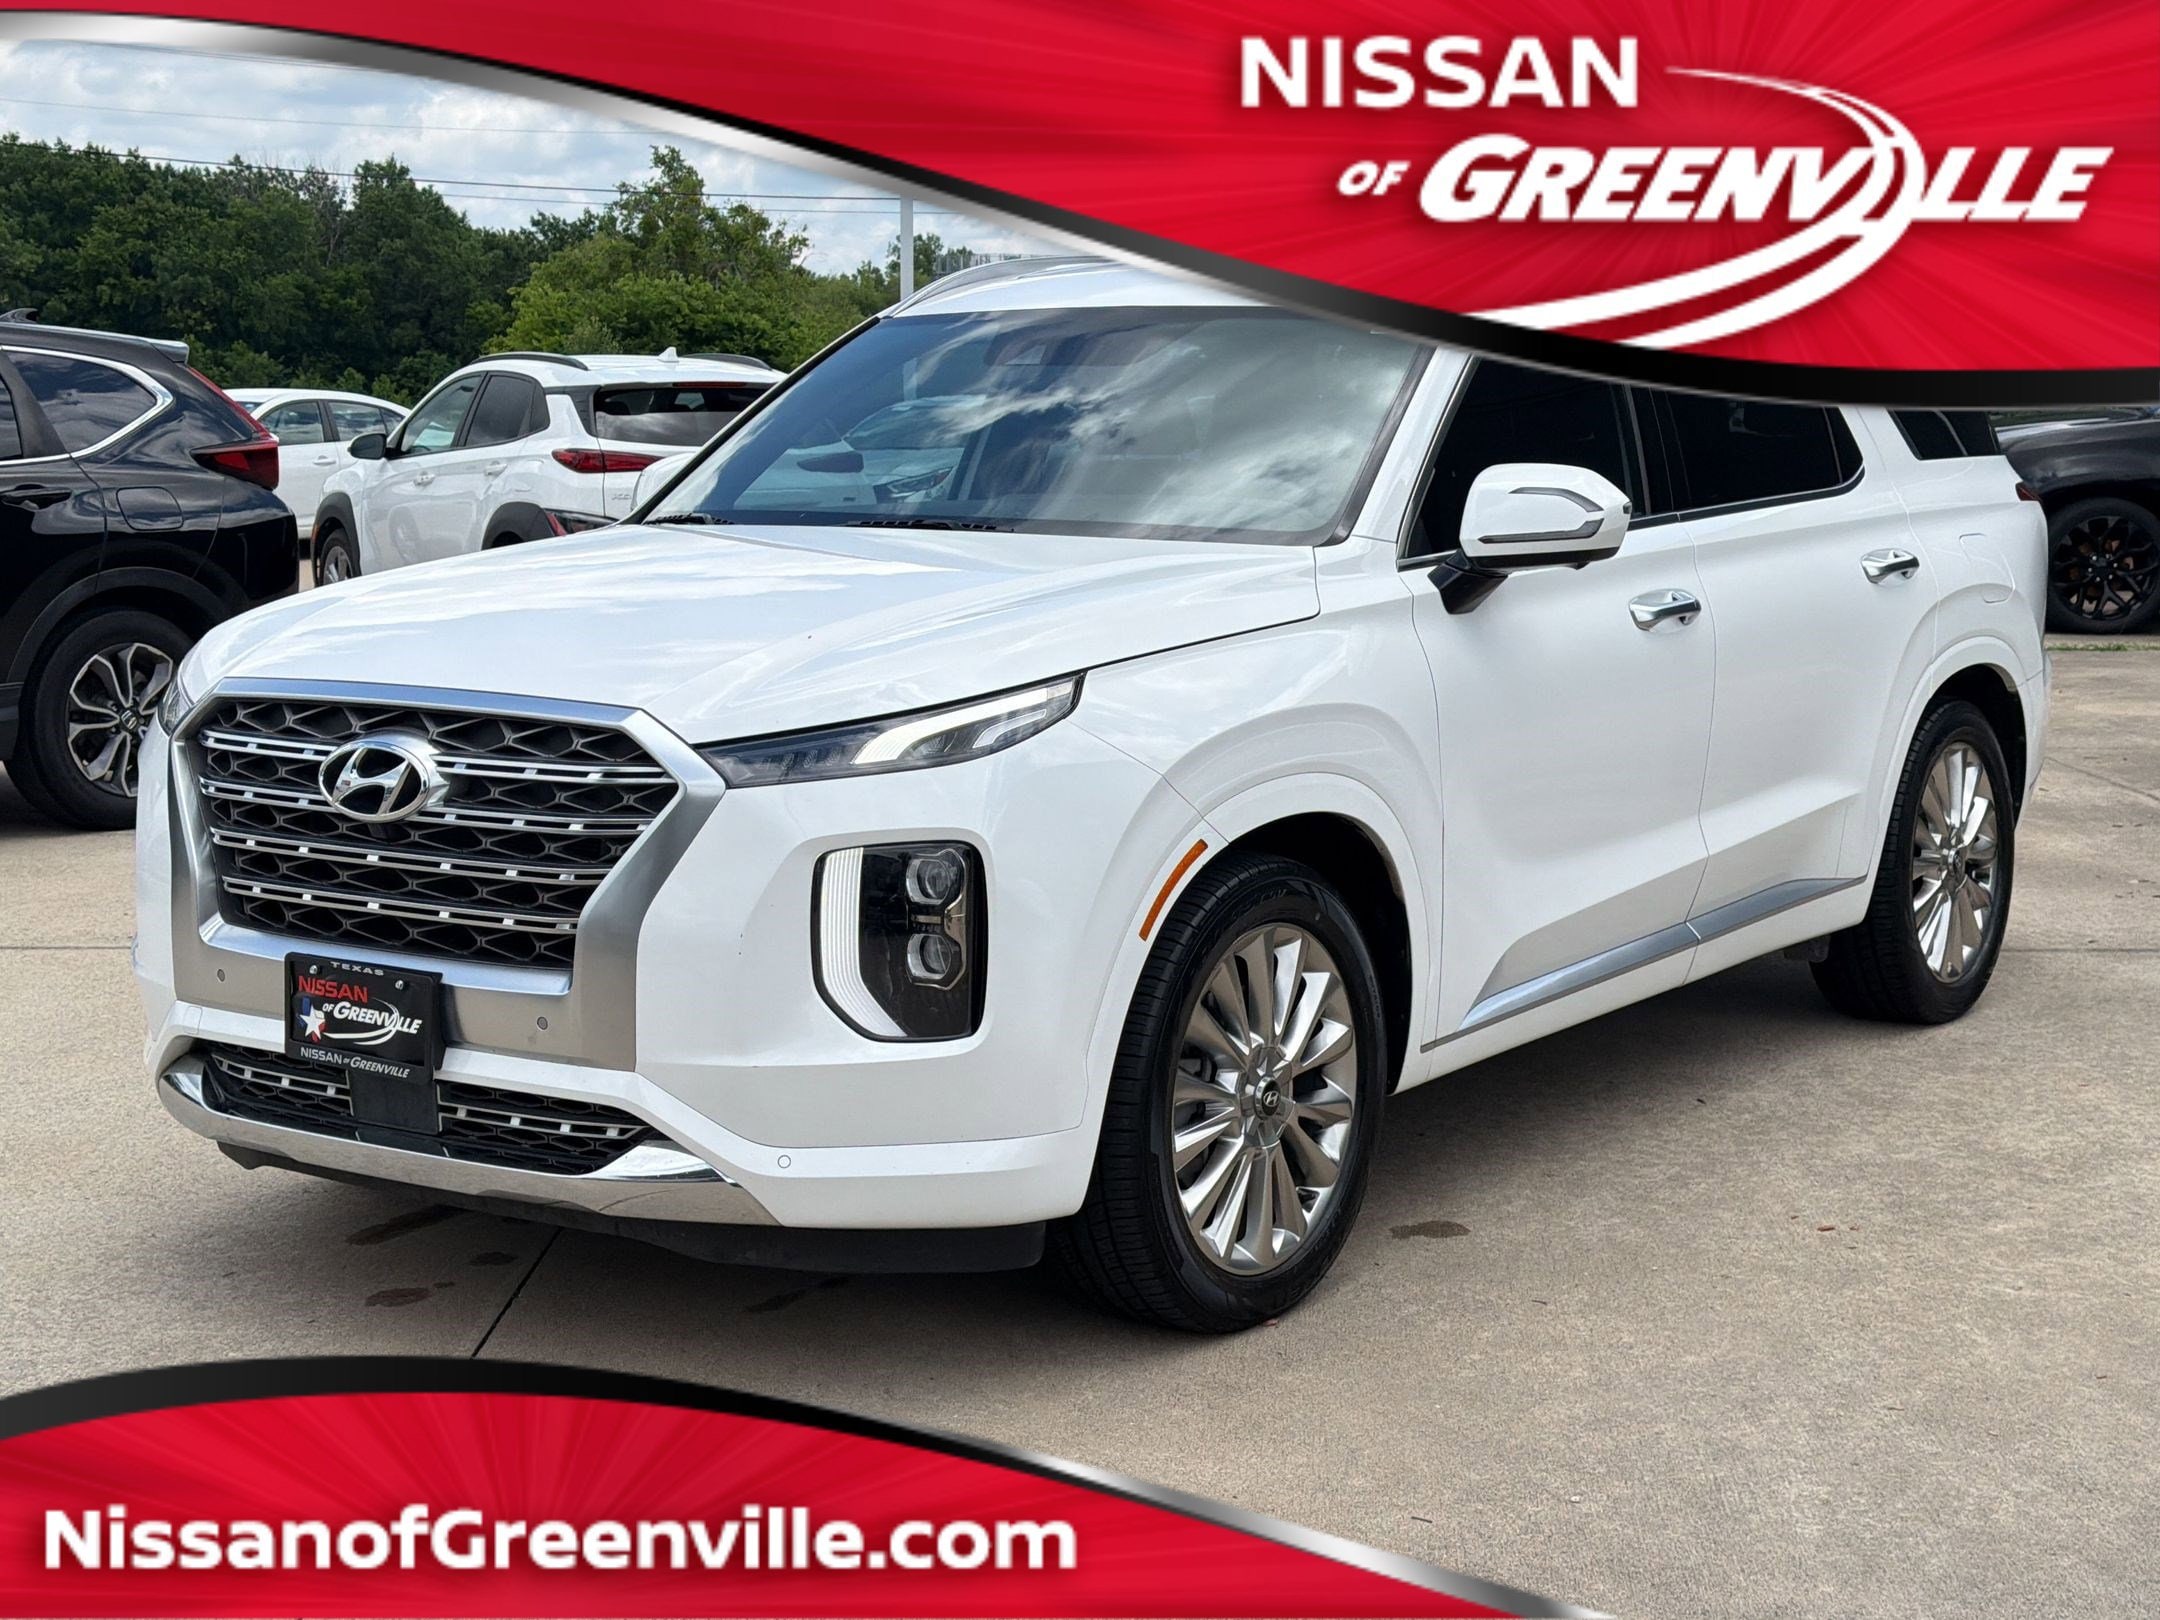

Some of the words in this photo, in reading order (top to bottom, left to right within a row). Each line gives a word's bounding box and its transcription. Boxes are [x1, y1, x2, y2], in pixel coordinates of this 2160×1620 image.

[330, 961, 384, 976] TEXAS
[298, 975, 368, 1004] NISSAN
[322, 1003, 335, 1013] OF
[333, 1001, 422, 1034] GREENVILLE
[300, 1046, 342, 1065] NISSAN
[350, 1056, 410, 1078] GREENVILLE
